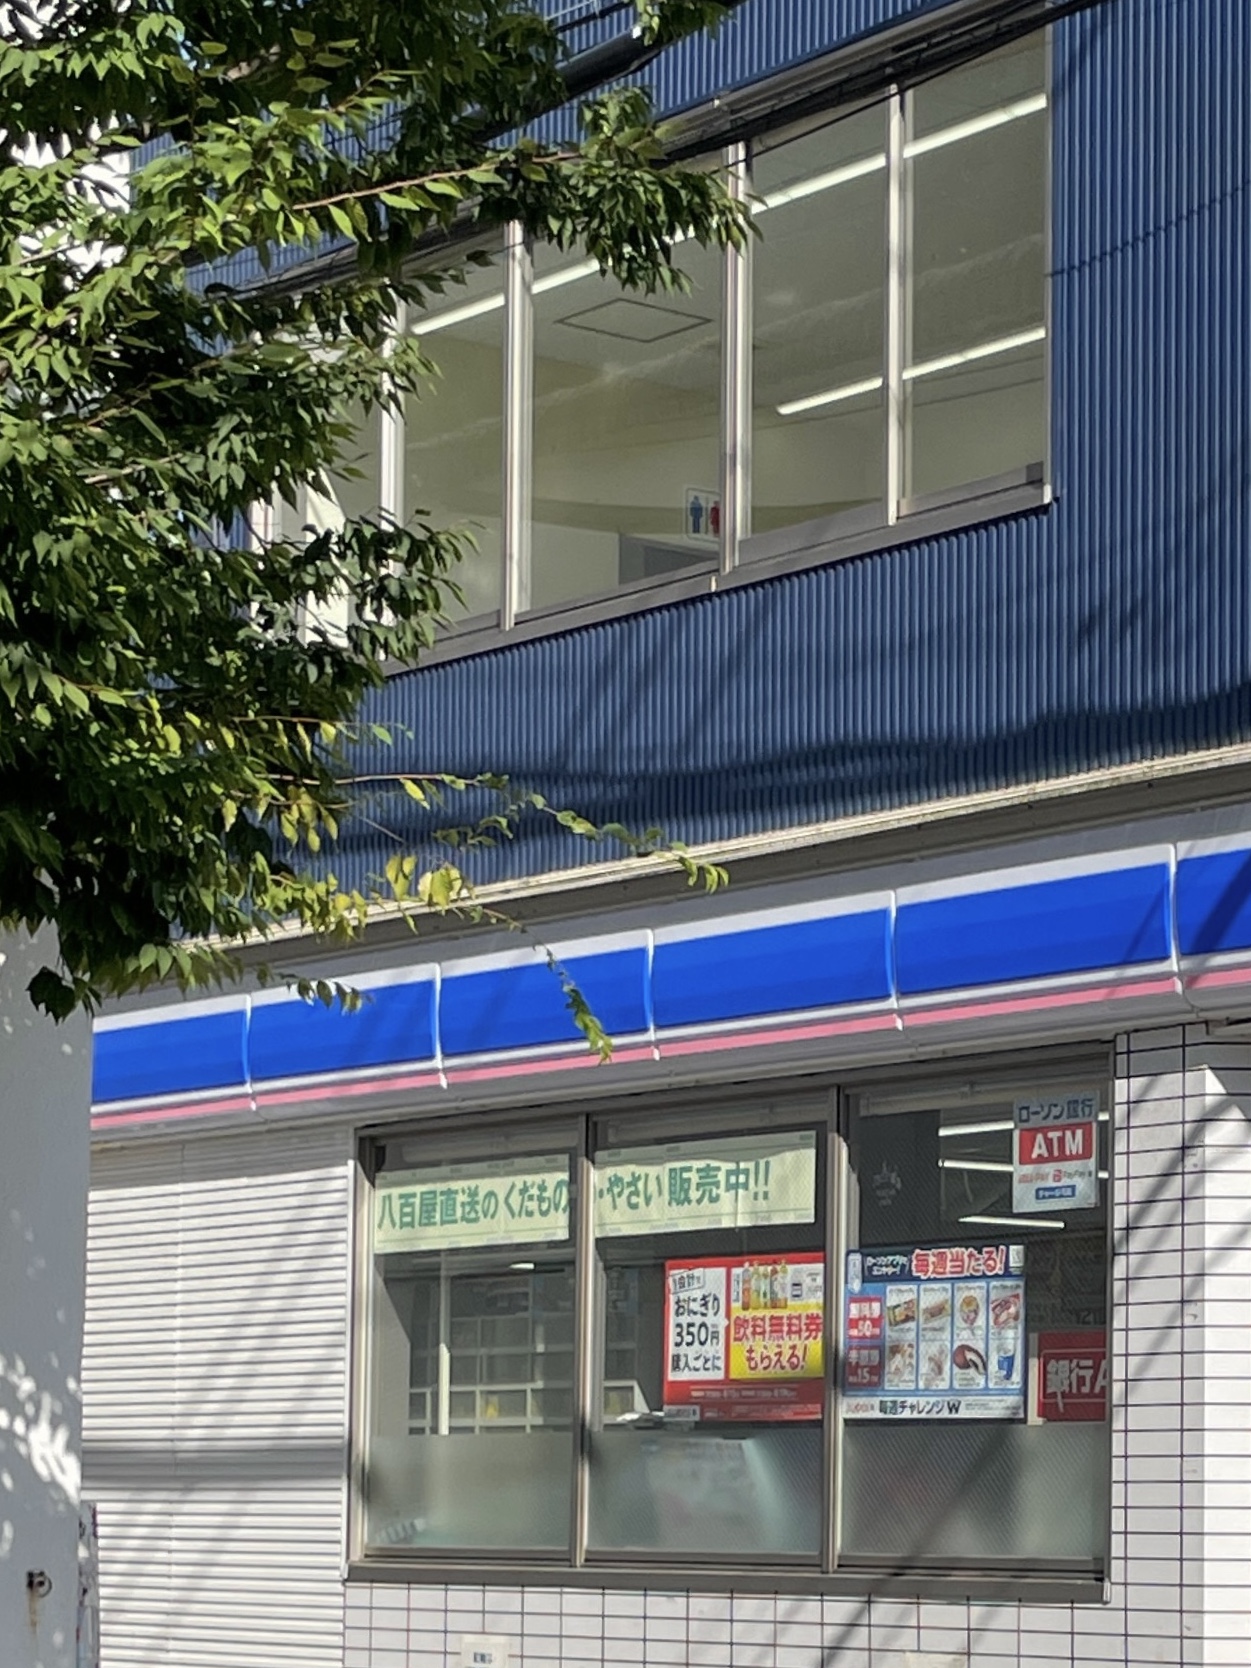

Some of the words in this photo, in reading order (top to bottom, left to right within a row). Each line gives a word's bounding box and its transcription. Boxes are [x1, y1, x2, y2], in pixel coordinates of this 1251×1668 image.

[1031, 1129, 1083, 1159] ATM
[913, 1247, 1006, 1278] 毎週当たる!
[675, 1293, 720, 1317] おにぎり
[733, 1313, 823, 1342] 飲料無料券
[746, 1344, 807, 1371] もらえる!
